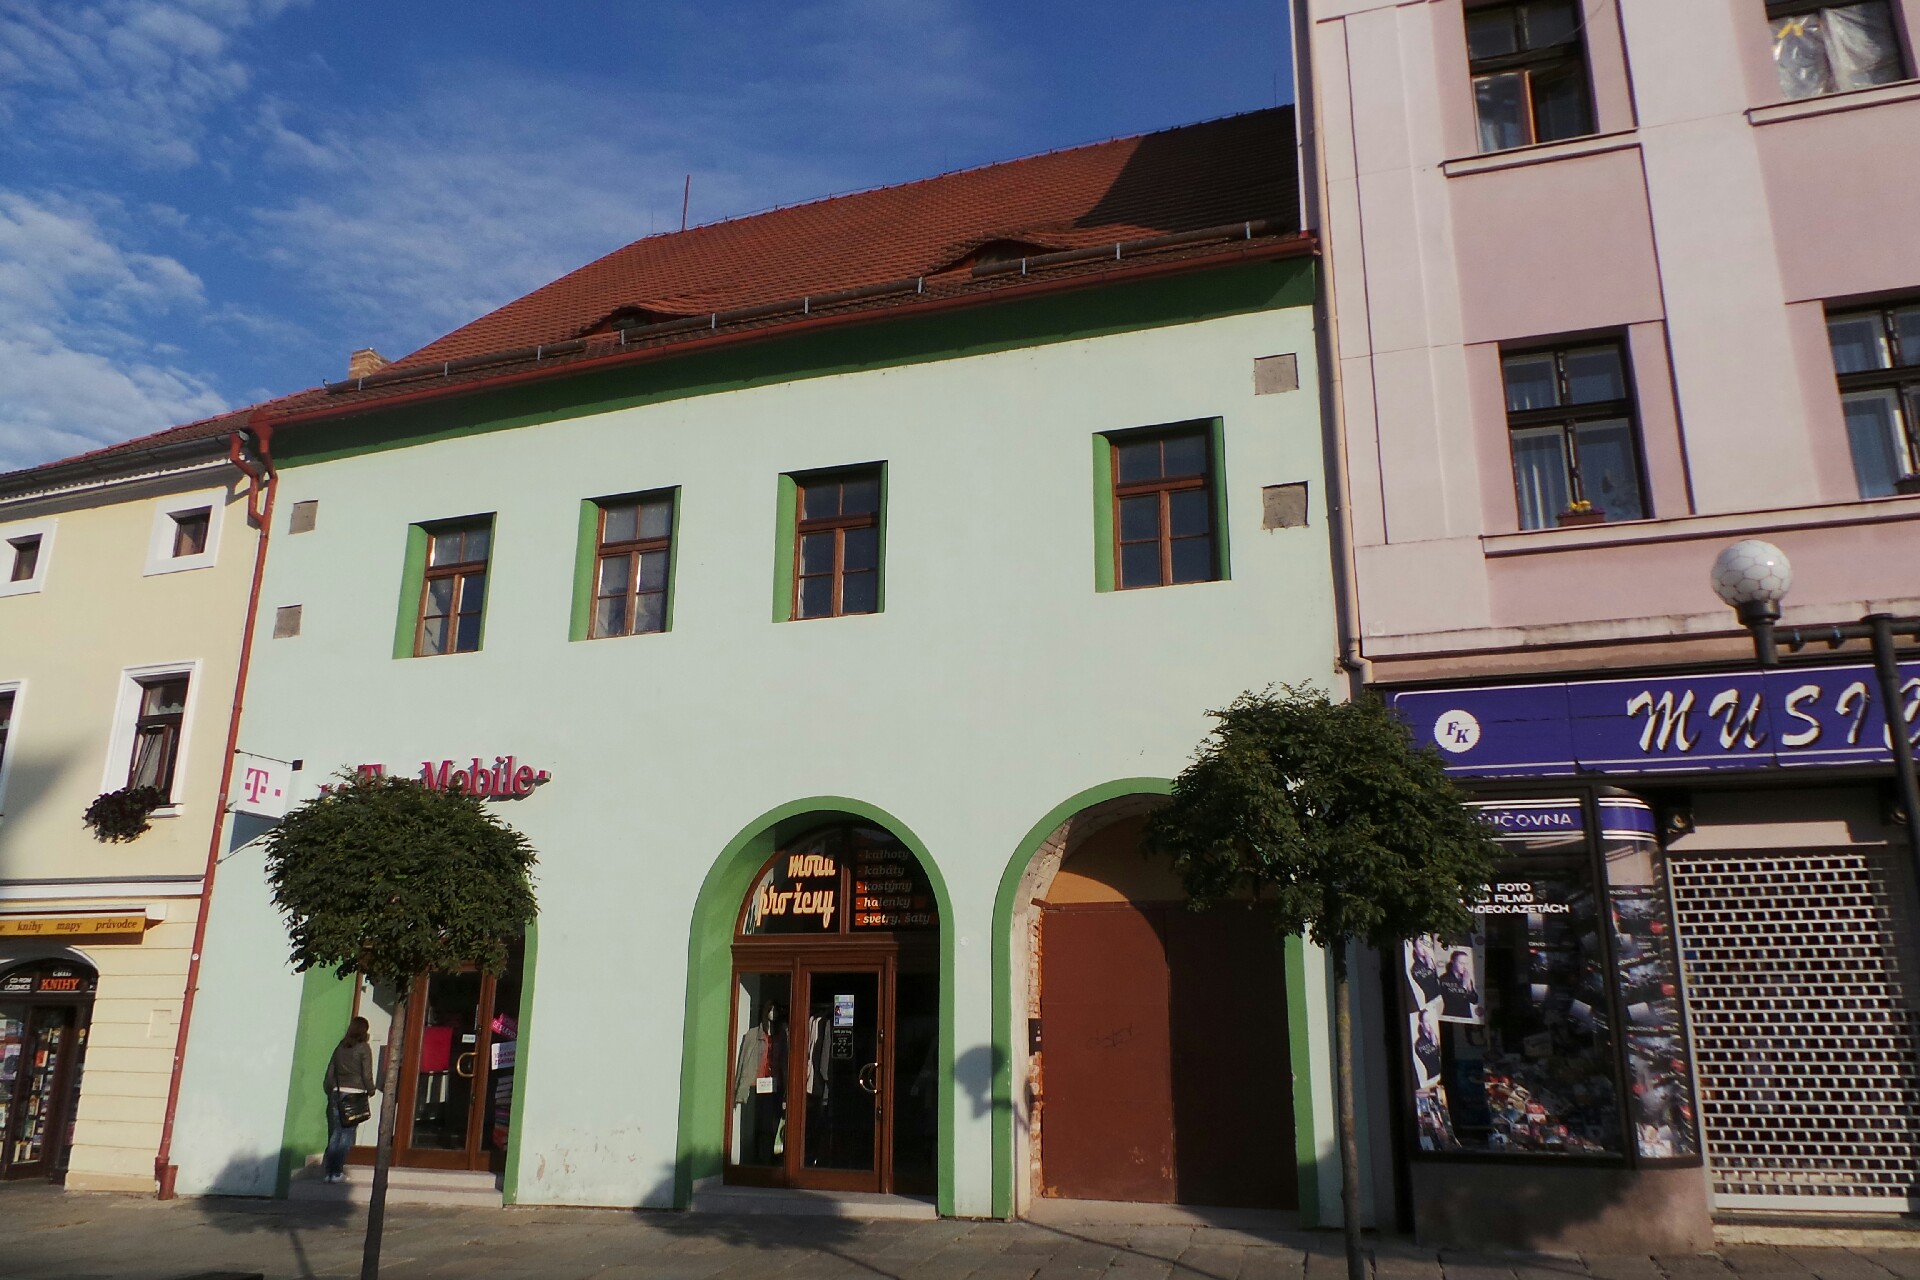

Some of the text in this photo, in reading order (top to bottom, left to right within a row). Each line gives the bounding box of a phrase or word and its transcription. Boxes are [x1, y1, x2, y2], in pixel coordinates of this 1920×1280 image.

[1446, 721, 1471, 744] FK
[1497, 882, 1531, 893] FOTO
[864, 897, 911, 909] halenky
[1494, 892, 1534, 903] FILMŮ
[756, 882, 836, 929] pro ženy
[17, 921, 43, 933] knihy
[56, 921, 82, 932] mapy
[94, 918, 138, 931] průvodce
[41, 977, 80, 990] KNIHY
